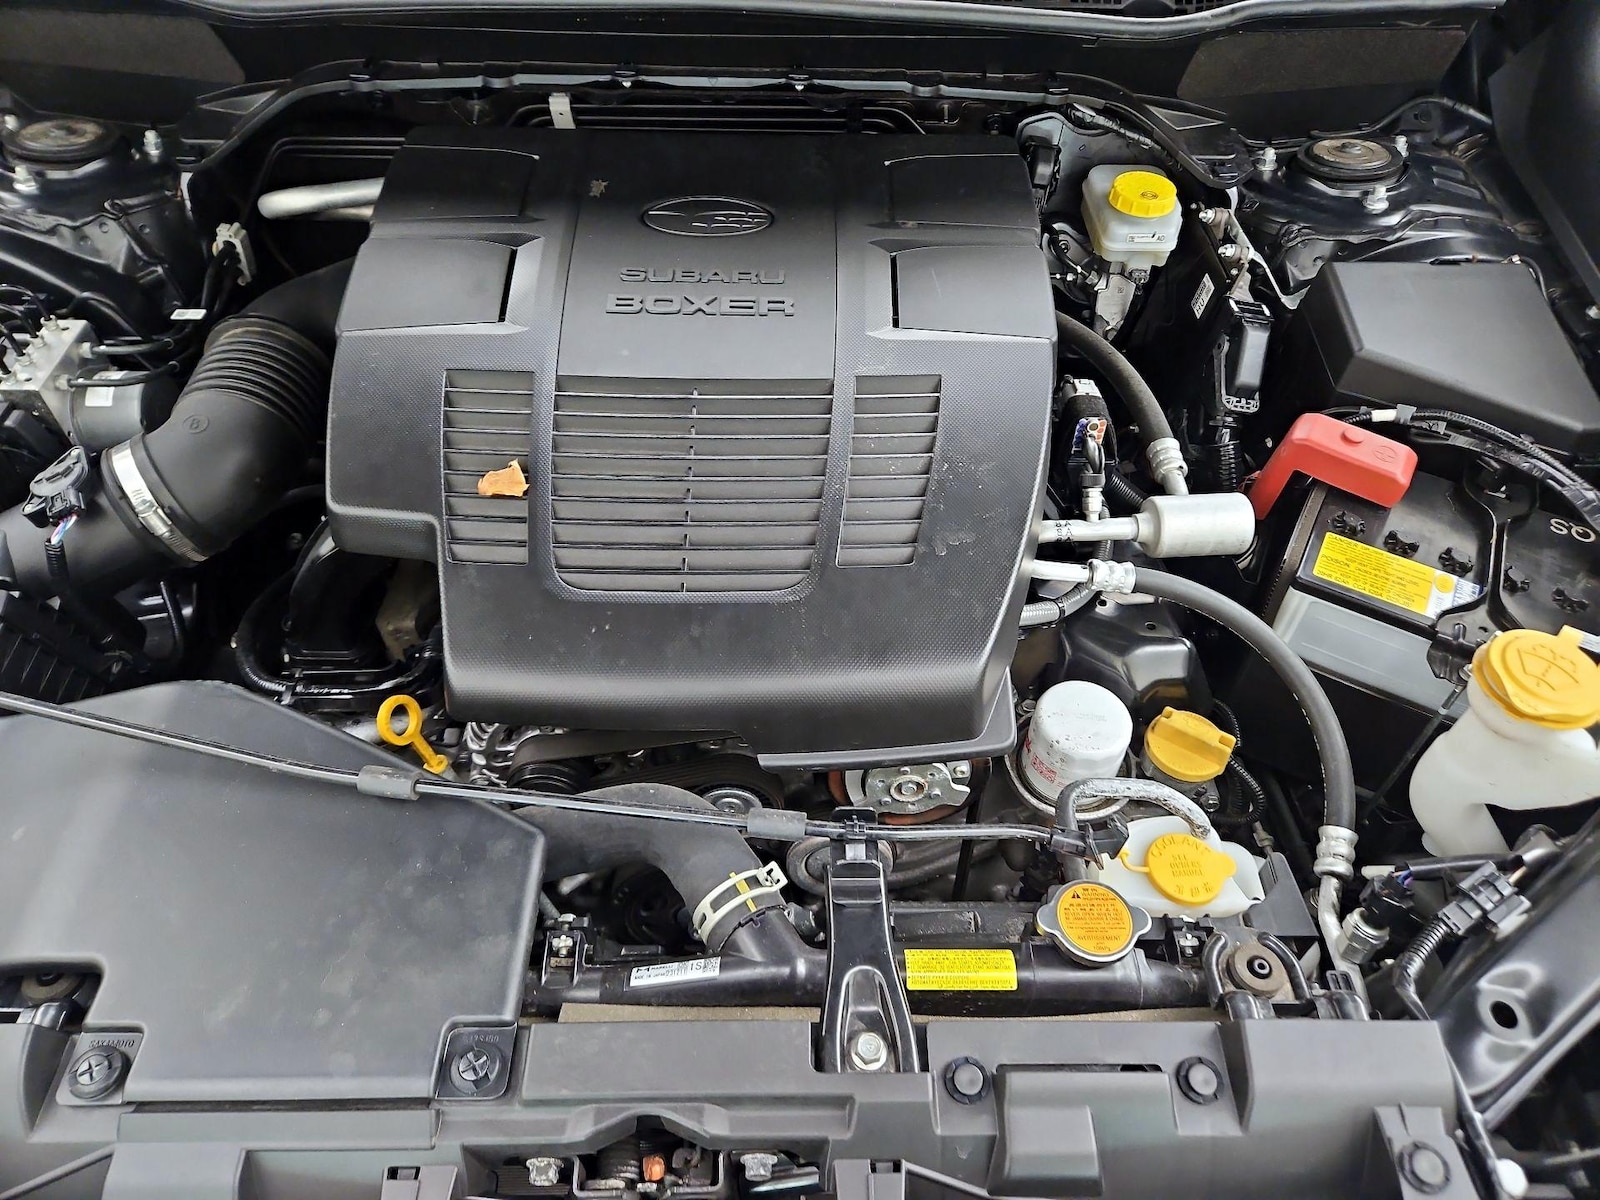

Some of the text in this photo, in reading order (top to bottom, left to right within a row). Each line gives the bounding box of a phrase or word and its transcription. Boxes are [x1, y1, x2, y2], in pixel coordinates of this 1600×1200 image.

[619, 266, 785, 285] SUBARU
[605, 293, 795, 317] BOXER
[1328, 534, 1359, 548] DANGER
[1321, 554, 1351, 568] POISON
